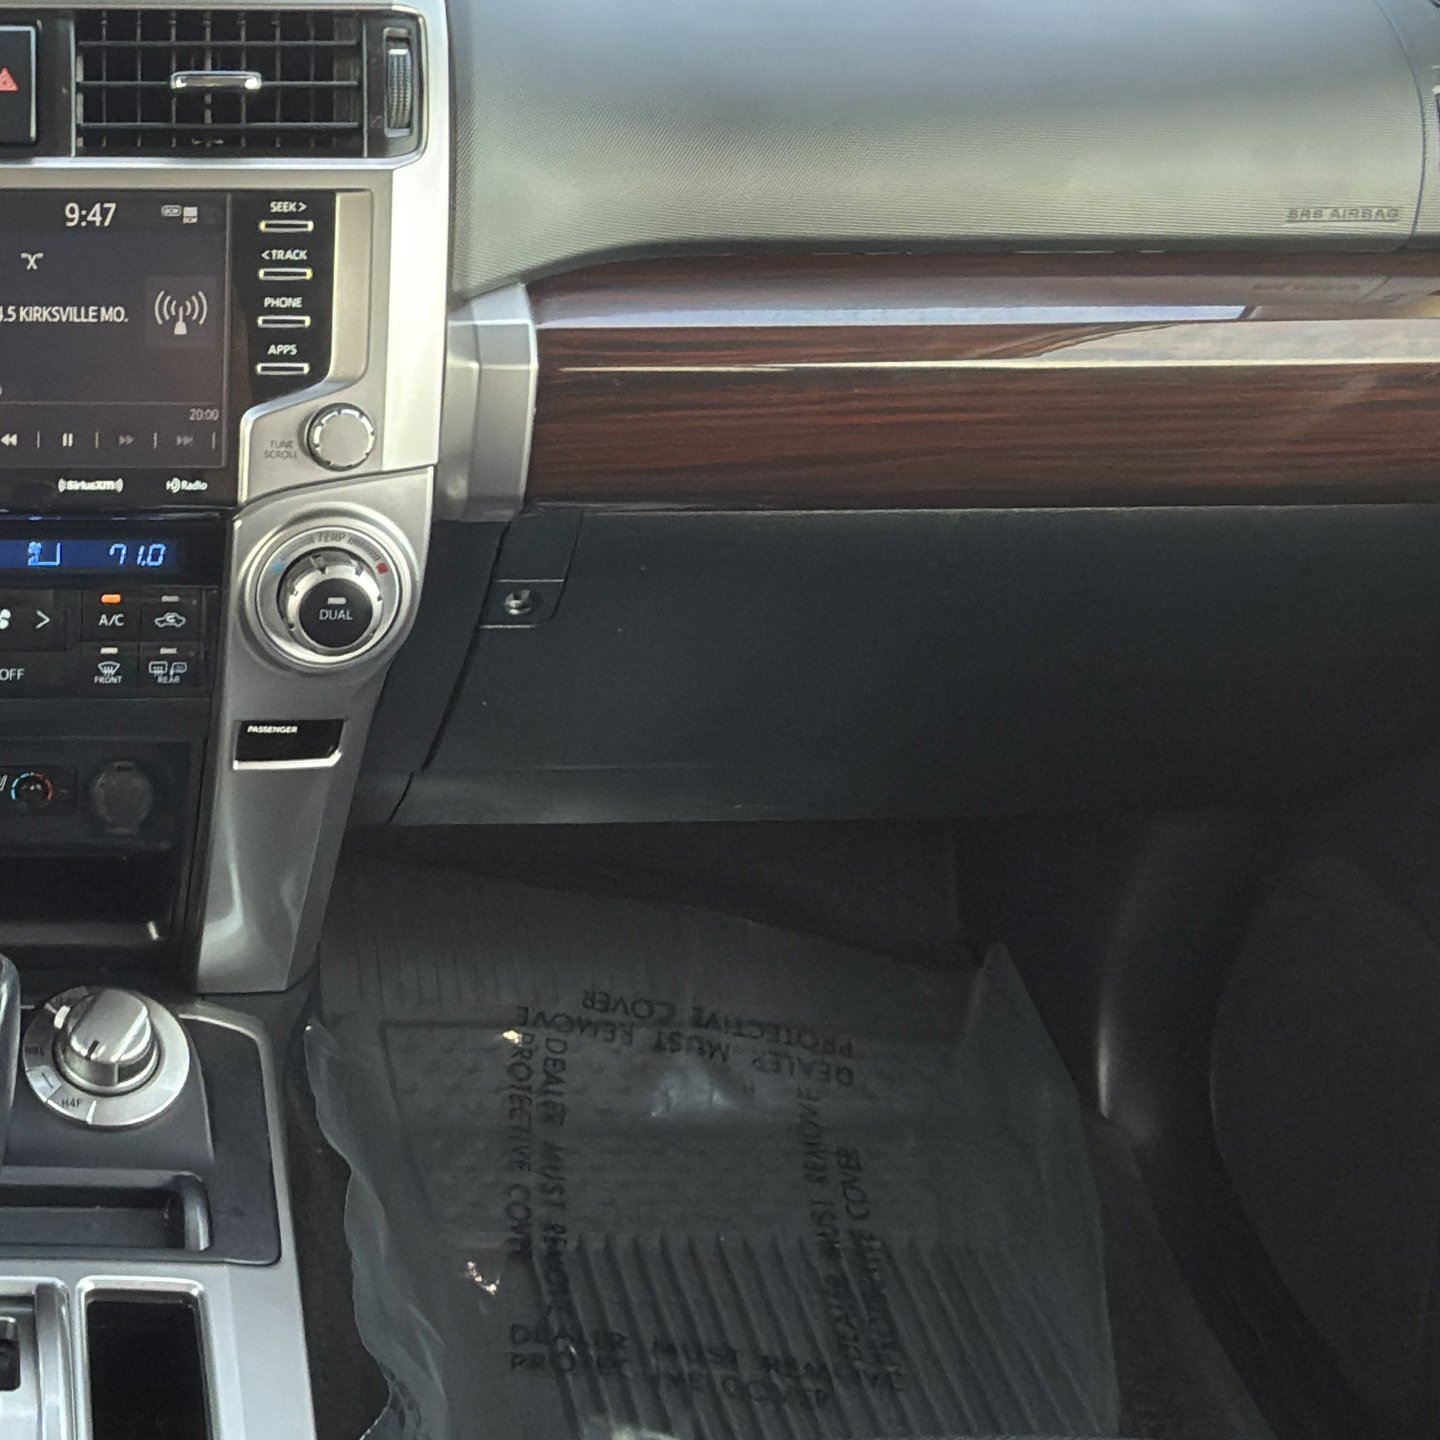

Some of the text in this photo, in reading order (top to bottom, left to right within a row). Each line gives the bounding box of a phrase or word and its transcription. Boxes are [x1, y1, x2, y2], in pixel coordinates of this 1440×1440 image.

[64, 202, 116, 227] 9:47
[264, 297, 303, 308] PHONE
[19, 306, 98, 322] KIRKSVILLE
[100, 306, 129, 322] MO.
[268, 344, 297, 355] APPS
[189, 409, 219, 421] 20:00
[182, 480, 208, 491] Radio
[98, 613, 125, 627] A/C
[319, 609, 353, 622] DUAL
[94, 675, 123, 684] FRONT
[157, 675, 181, 684] REAR
[247, 725, 298, 734] PASSENGER
[581, 989, 677, 1026] COVER
